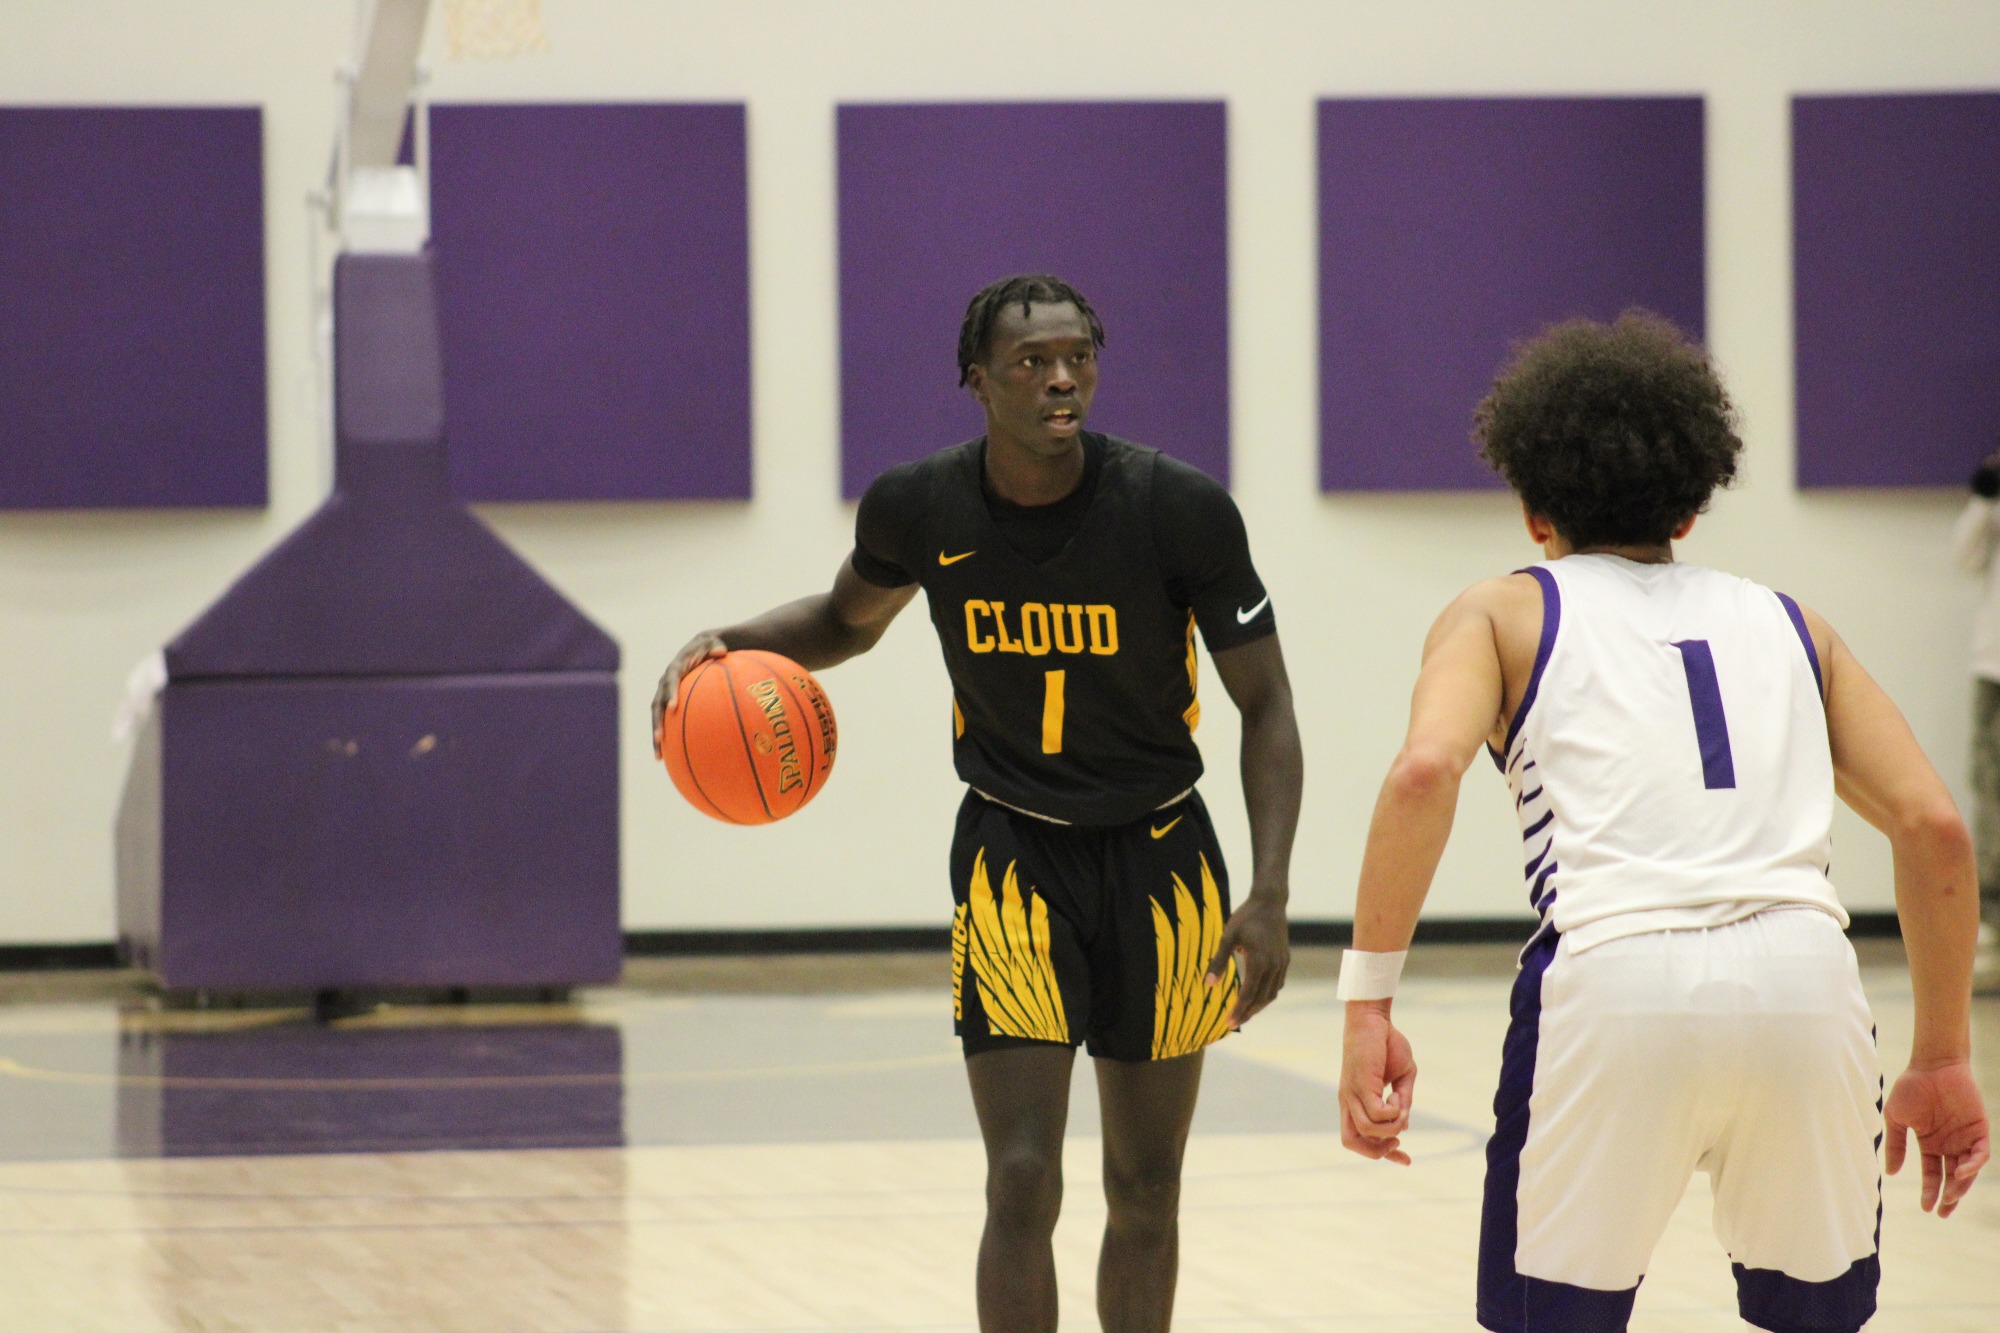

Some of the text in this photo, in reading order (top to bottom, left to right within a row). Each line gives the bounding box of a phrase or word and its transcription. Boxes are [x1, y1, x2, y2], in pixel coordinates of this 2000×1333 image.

[964, 599, 1119, 656] CLOUD
[747, 677, 803, 795] SPALDING
[1042, 670, 1065, 754] 1
[1668, 639, 1736, 789] 1
